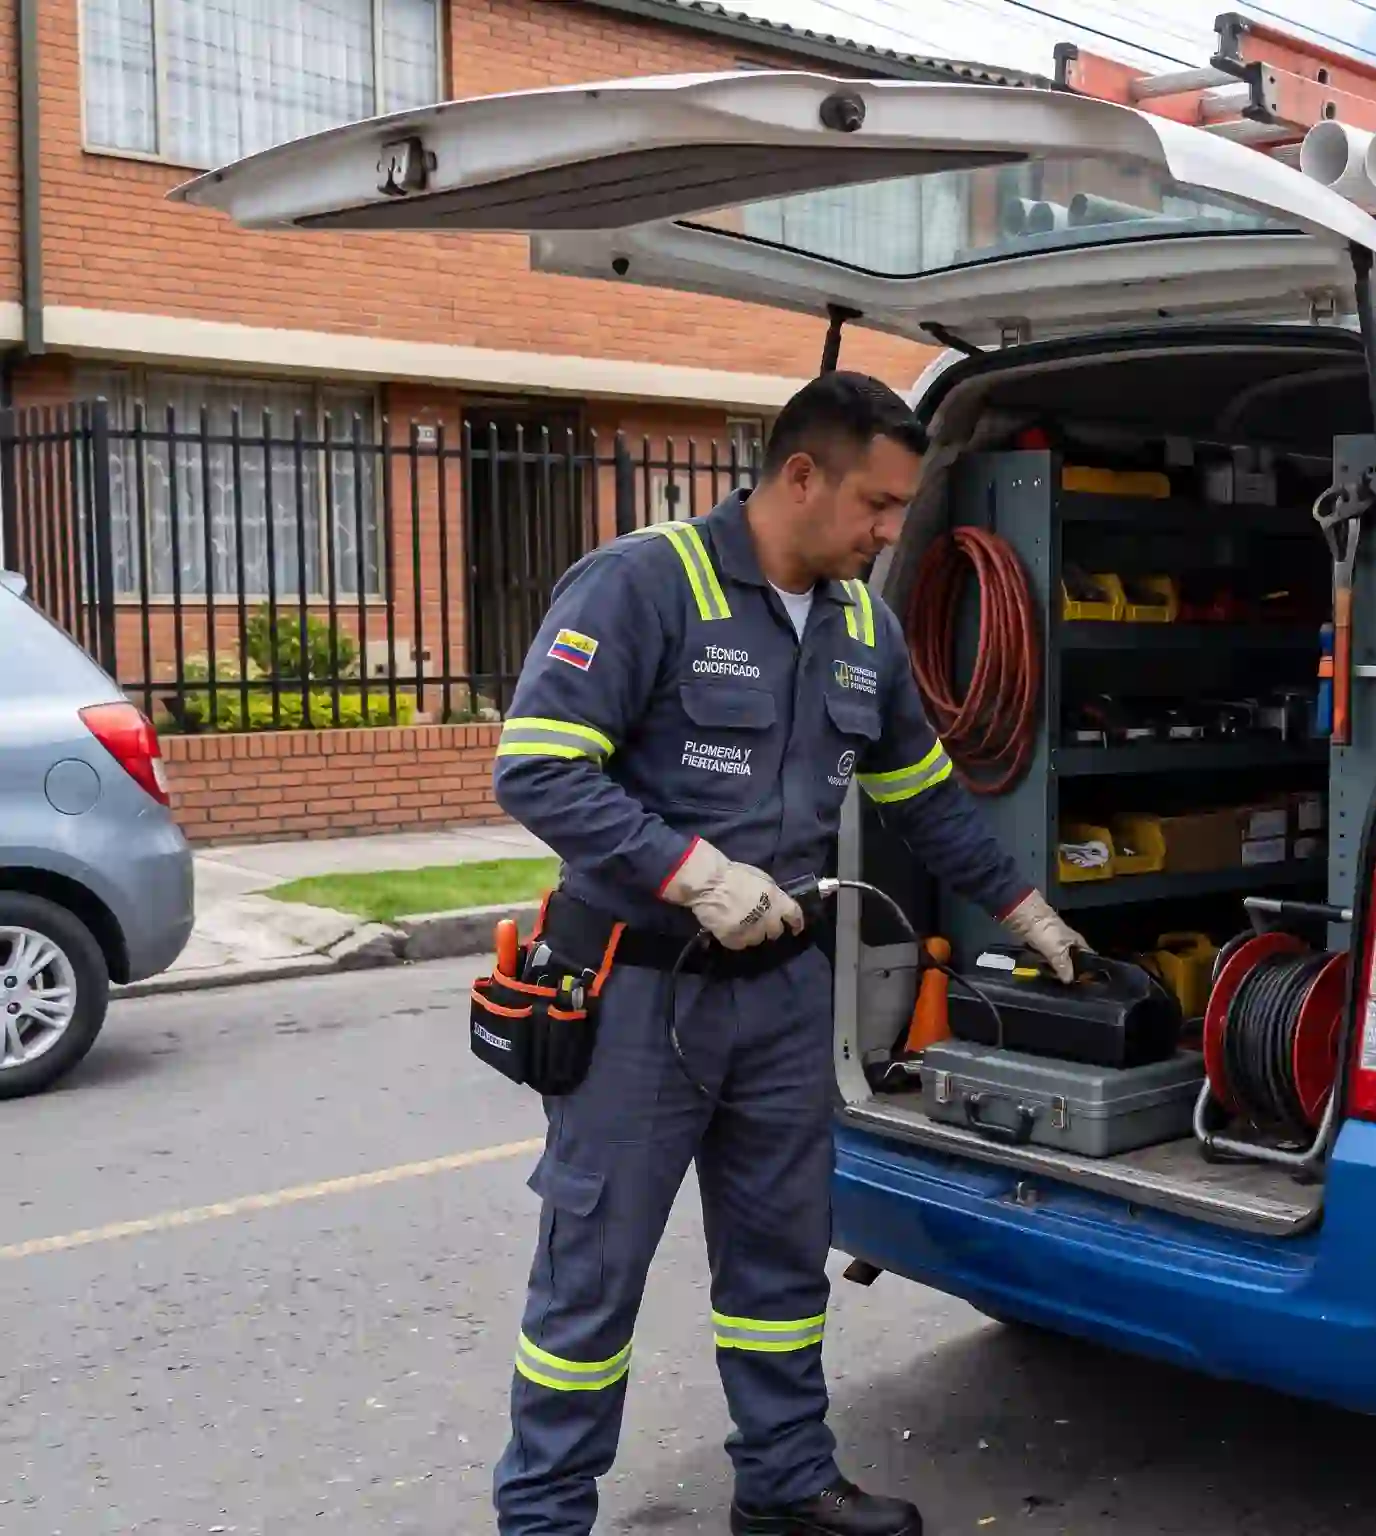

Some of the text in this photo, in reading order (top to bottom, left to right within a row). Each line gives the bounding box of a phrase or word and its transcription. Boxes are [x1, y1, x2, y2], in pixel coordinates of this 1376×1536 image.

[705, 644, 748, 662] TÉCNICO
[684, 740, 752, 763] PLOMERÍA Y
